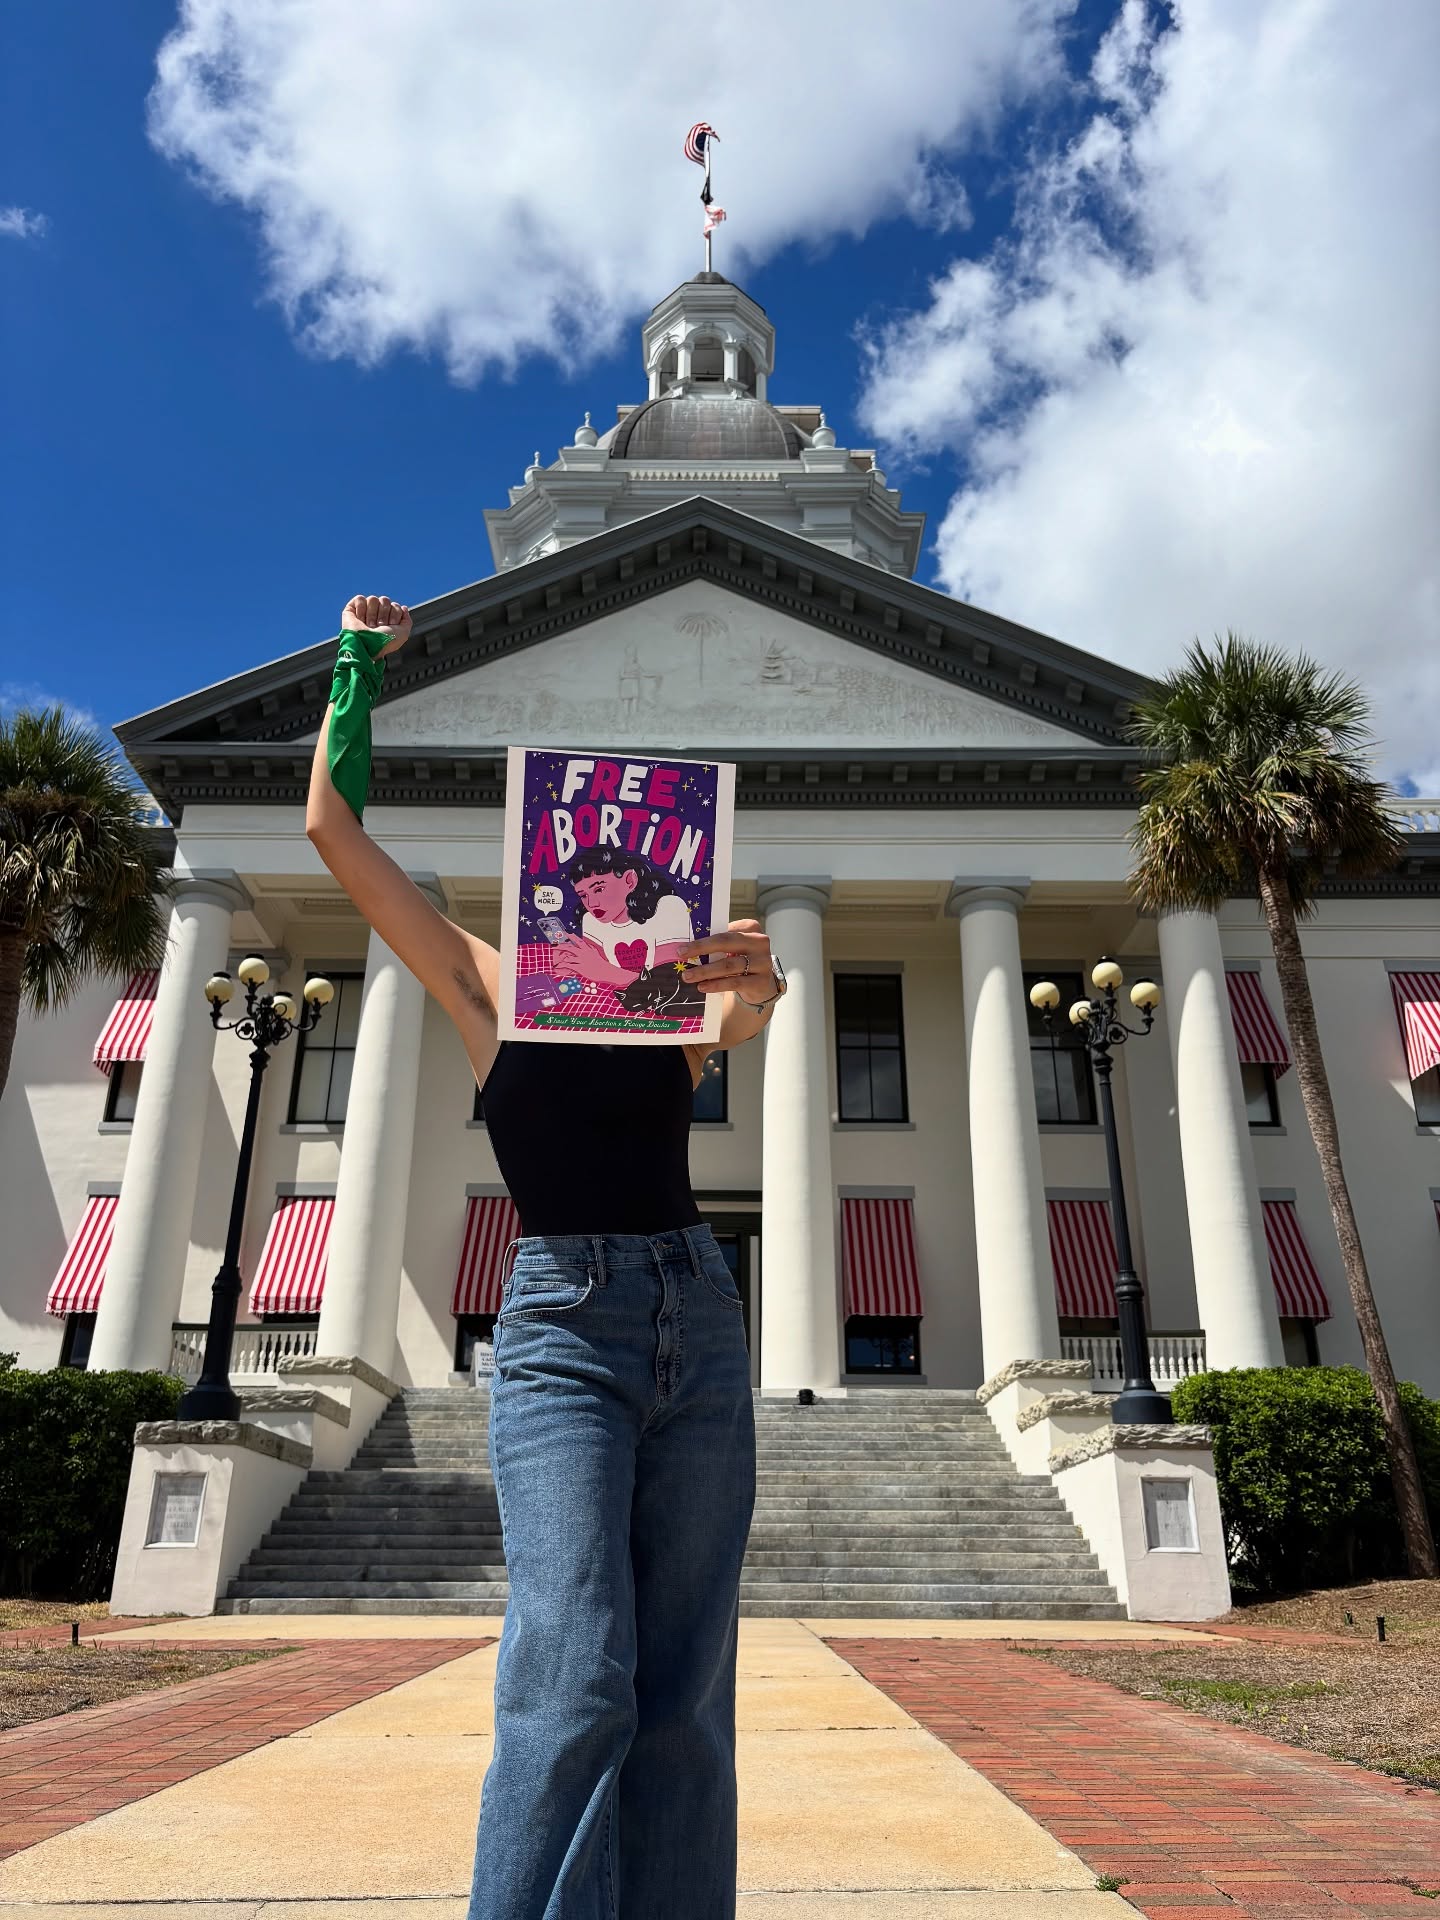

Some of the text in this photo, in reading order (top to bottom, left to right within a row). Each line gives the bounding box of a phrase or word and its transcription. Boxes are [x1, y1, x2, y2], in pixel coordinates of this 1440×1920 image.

[561, 759, 681, 809] FREE
[546, 1016, 568, 1025] Shout
[570, 1017, 586, 1025] Your
[588, 1018, 617, 1027] Abortion
[623, 1019, 646, 1028] Rouge
[647, 1020, 671, 1028] Doulas
